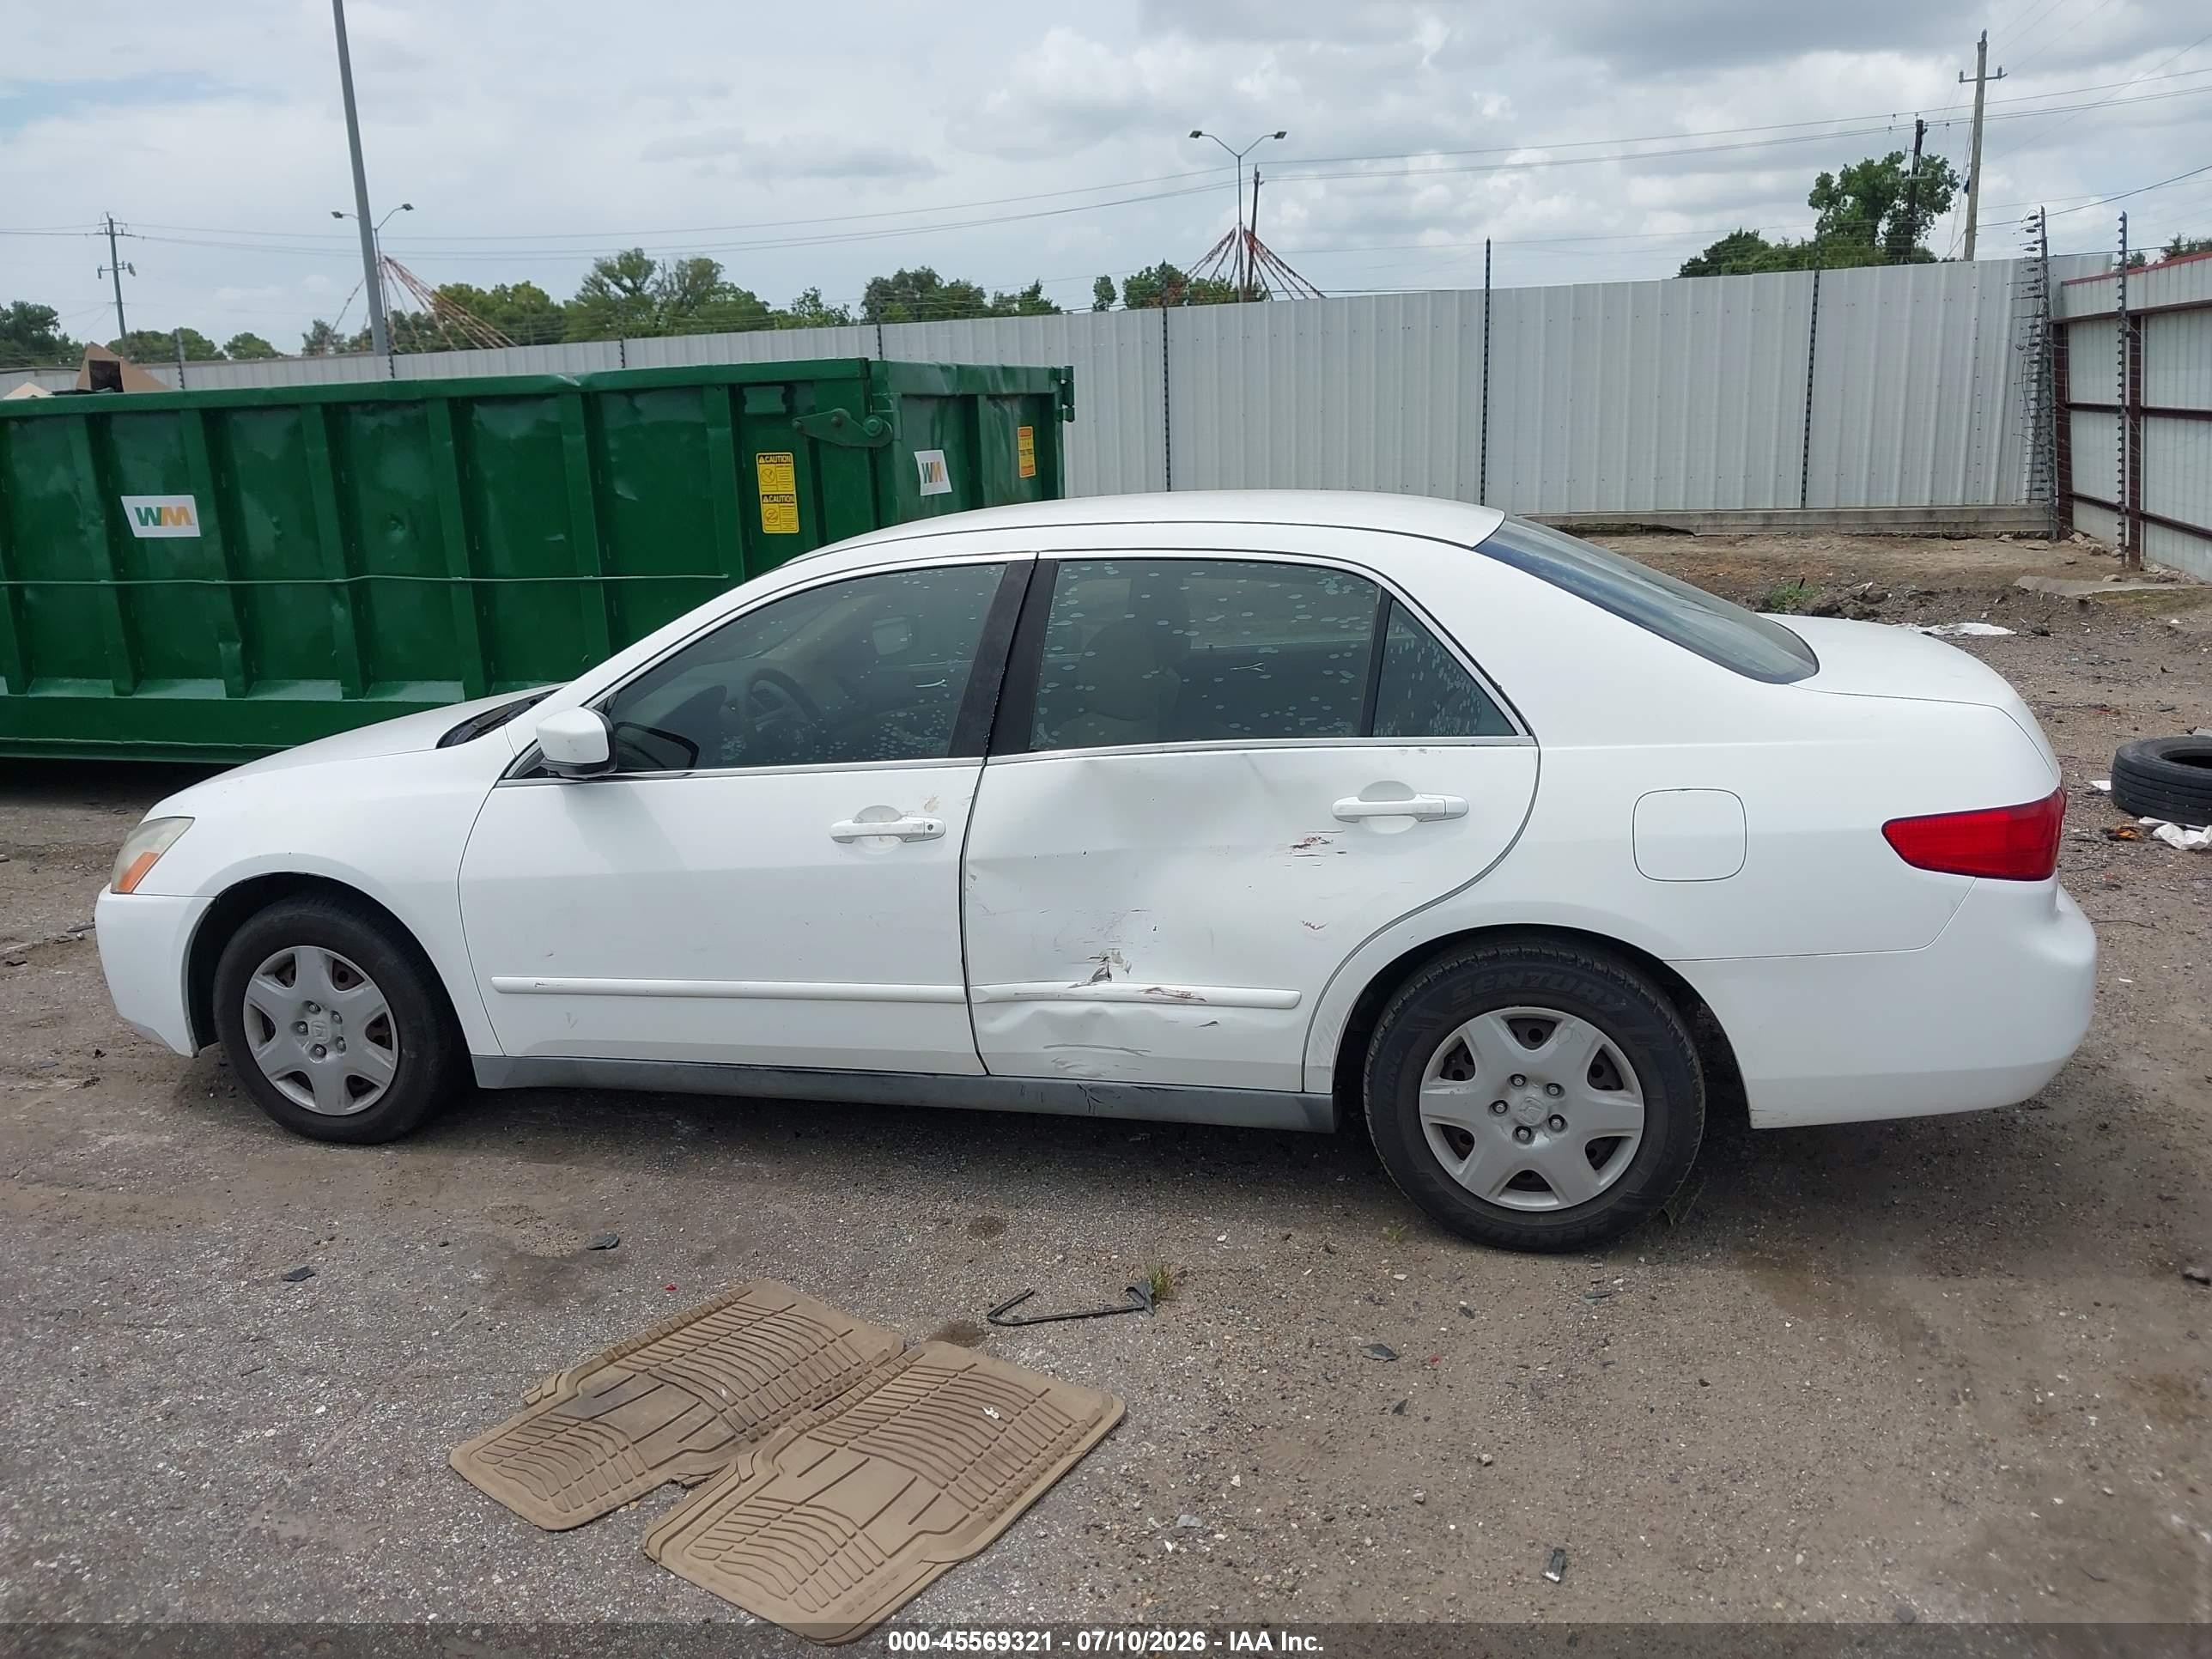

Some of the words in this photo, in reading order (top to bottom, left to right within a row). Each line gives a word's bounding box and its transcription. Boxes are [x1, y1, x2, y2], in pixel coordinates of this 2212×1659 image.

[764, 455, 792, 464] CAUTION
[921, 460, 944, 483] WM
[769, 495, 795, 503] CAUTION
[134, 507, 193, 526] WM
[1449, 970, 1628, 1007] SENTURY
